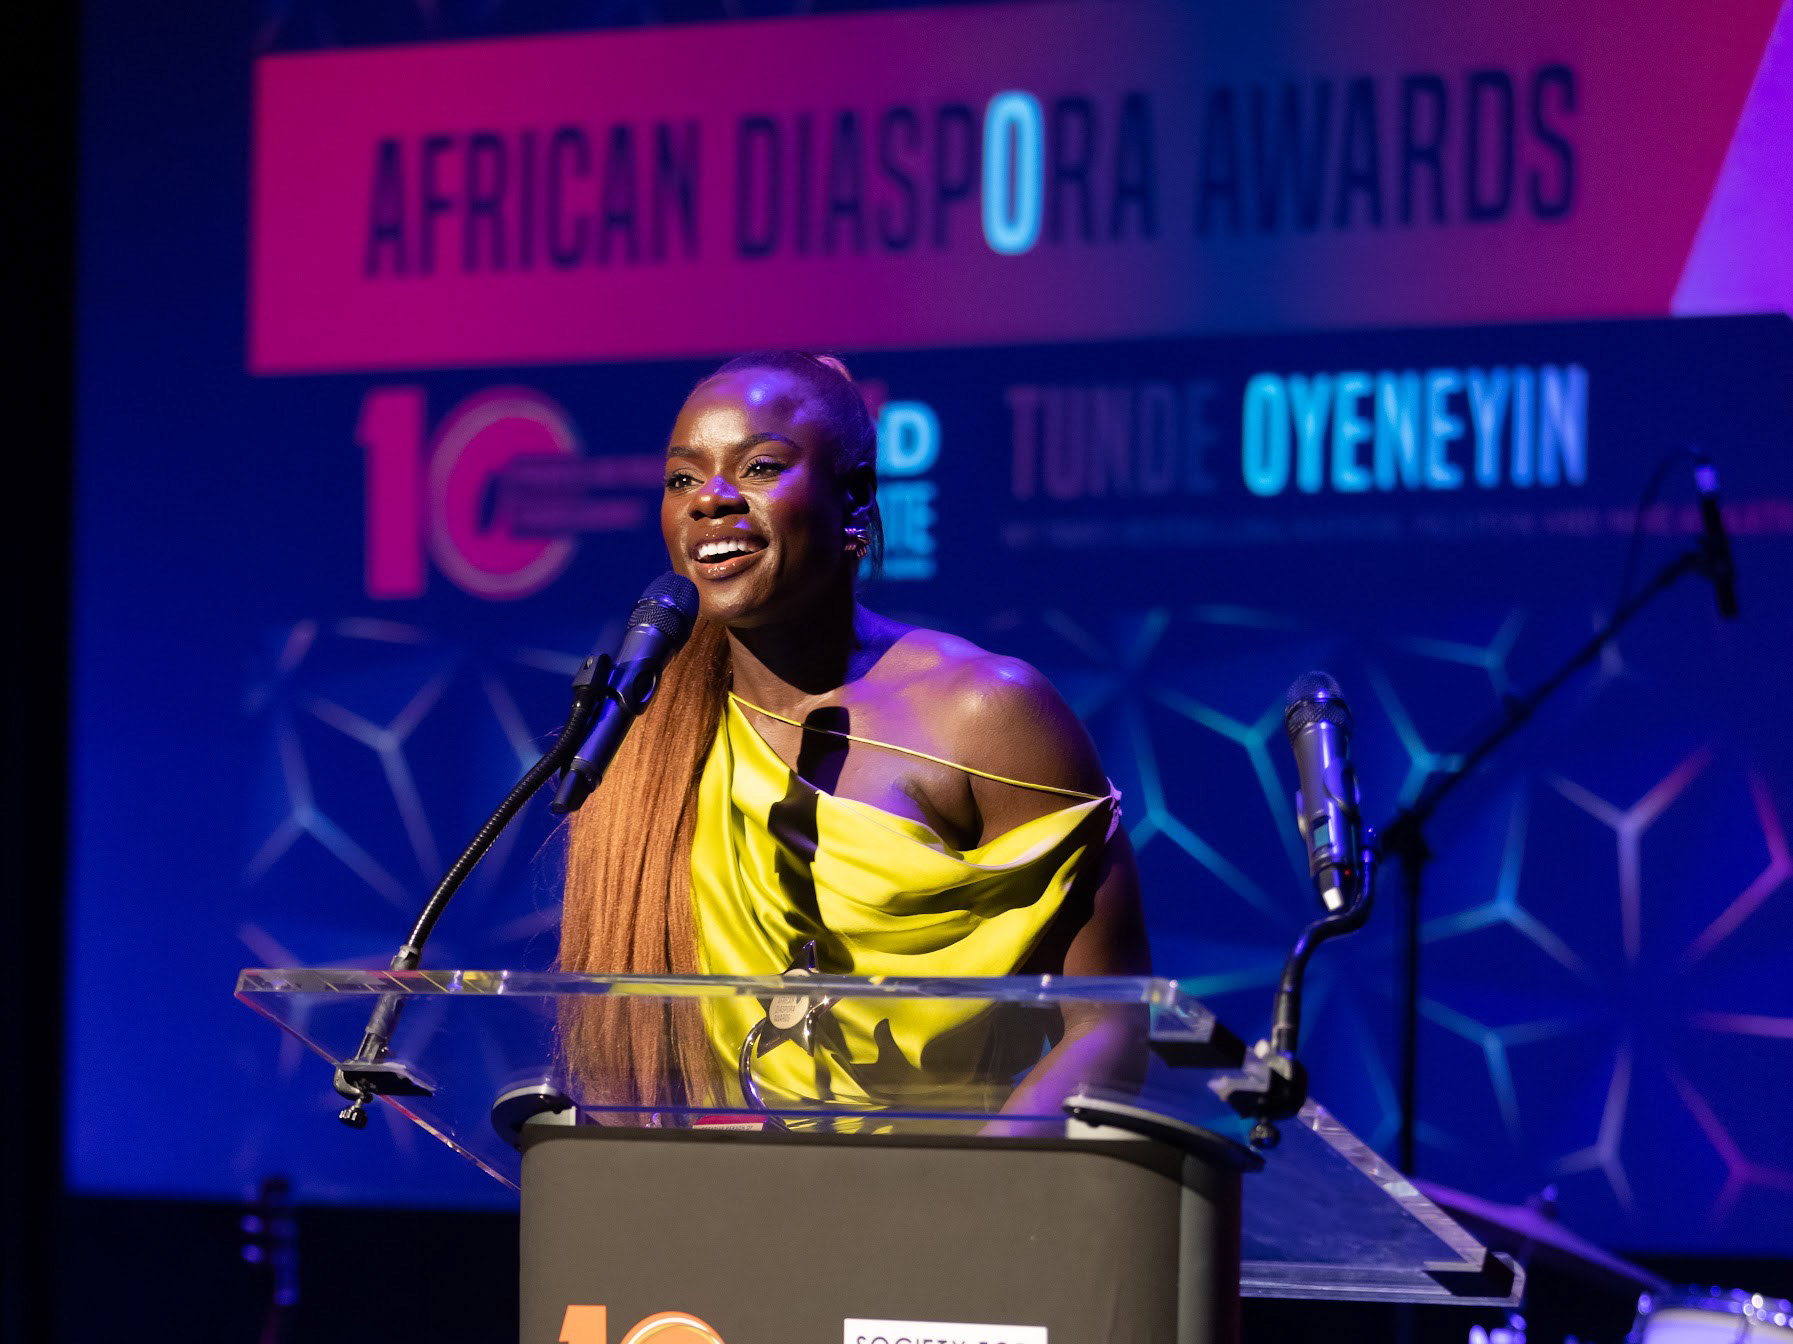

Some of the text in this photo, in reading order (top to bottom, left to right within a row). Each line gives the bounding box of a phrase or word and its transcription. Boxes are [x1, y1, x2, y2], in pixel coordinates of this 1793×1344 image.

[362, 63, 1579, 279] AFRICAN DIASPORA AWARDS
[1006, 381, 1222, 502] TUNDE
[1242, 363, 1589, 497] OYENEYIN
